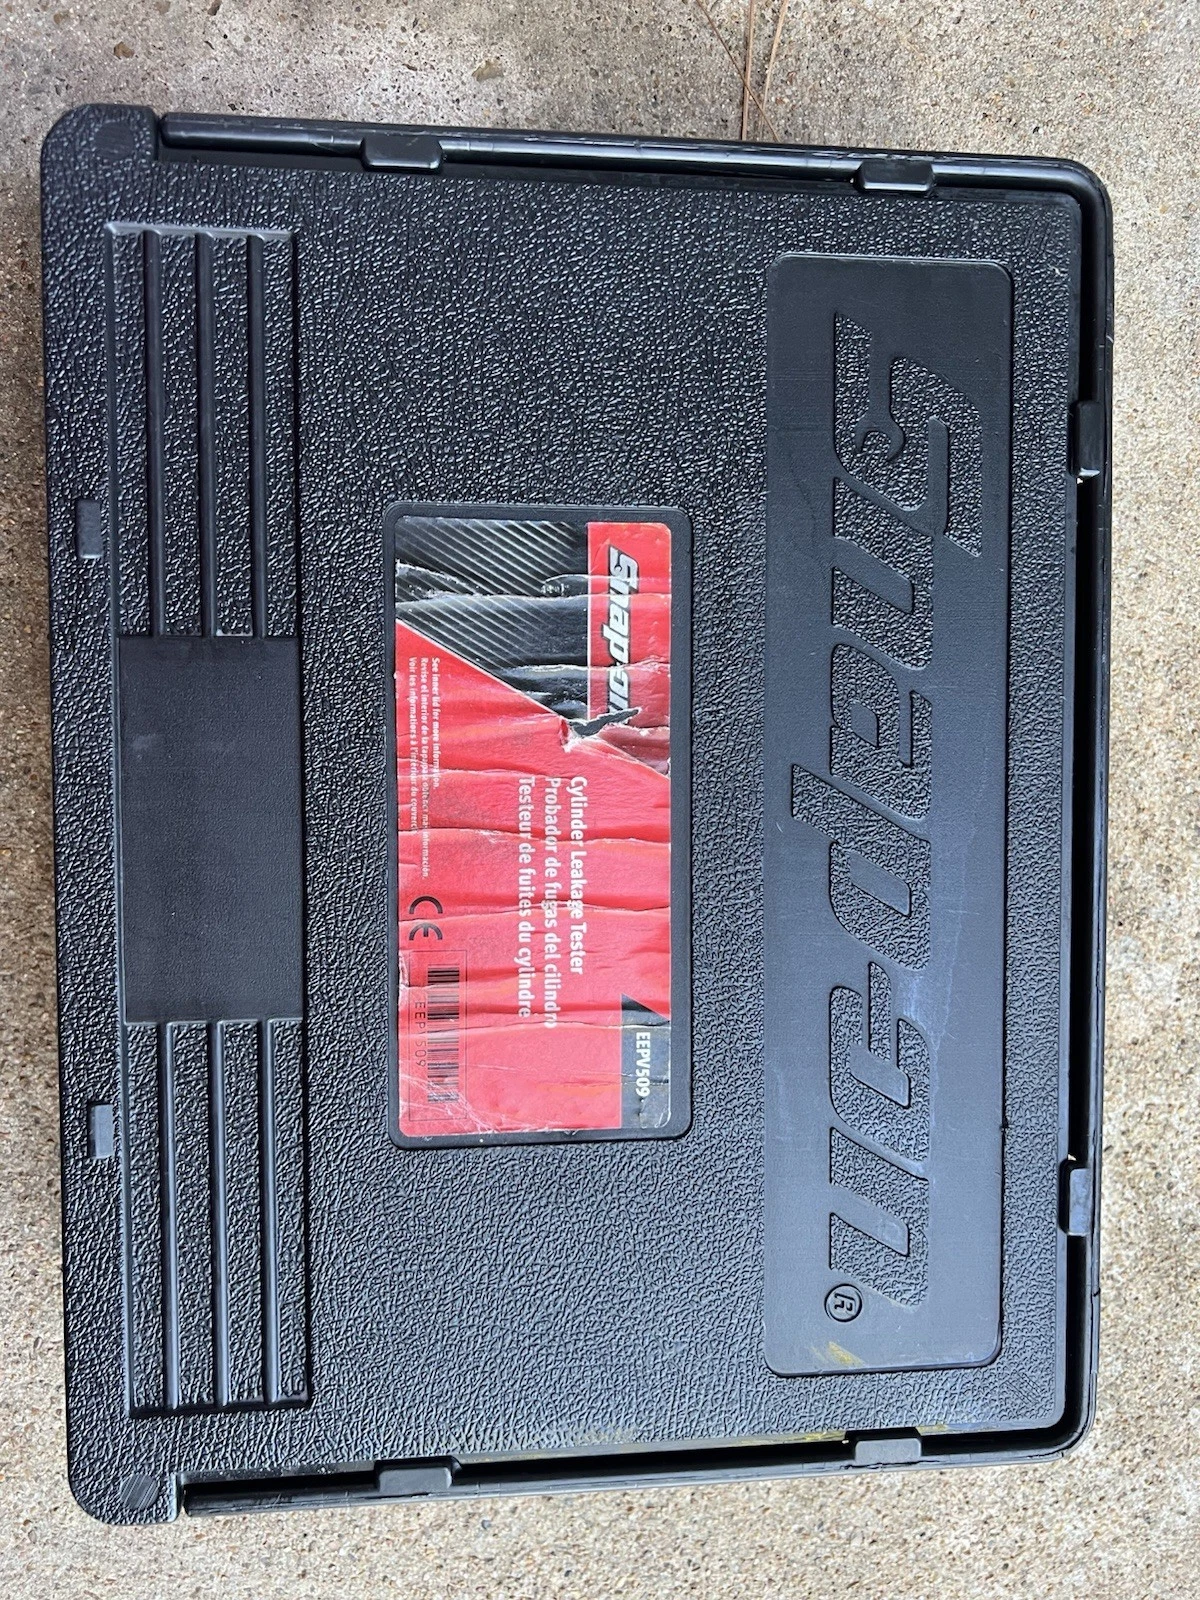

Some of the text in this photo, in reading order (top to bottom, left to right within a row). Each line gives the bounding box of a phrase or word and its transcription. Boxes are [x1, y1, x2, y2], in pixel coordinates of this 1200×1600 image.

[409, 656, 418, 673] Voir
[421, 657, 429, 684] Revise
[432, 657, 441, 673] See
[409, 674, 418, 687] les
[421, 684, 429, 693] el
[432, 673, 441, 695] inner
[421, 694, 429, 724] interior
[432, 696, 441, 708] lid
[432, 708, 441, 720] for
[421, 725, 430, 736] de
[432, 721, 440, 742] more
[421, 736, 430, 745] la
[411, 786, 419, 797] du
[791, 310, 983, 1313] Snap-on
[566, 776, 588, 975] Cylinder Leakage Tester
[514, 776, 536, 1018] Testeur de fuites du cylindre
[541, 777, 562, 1029] Probador de fugas del cilindro
[636, 1032, 651, 1097] EEPV509
